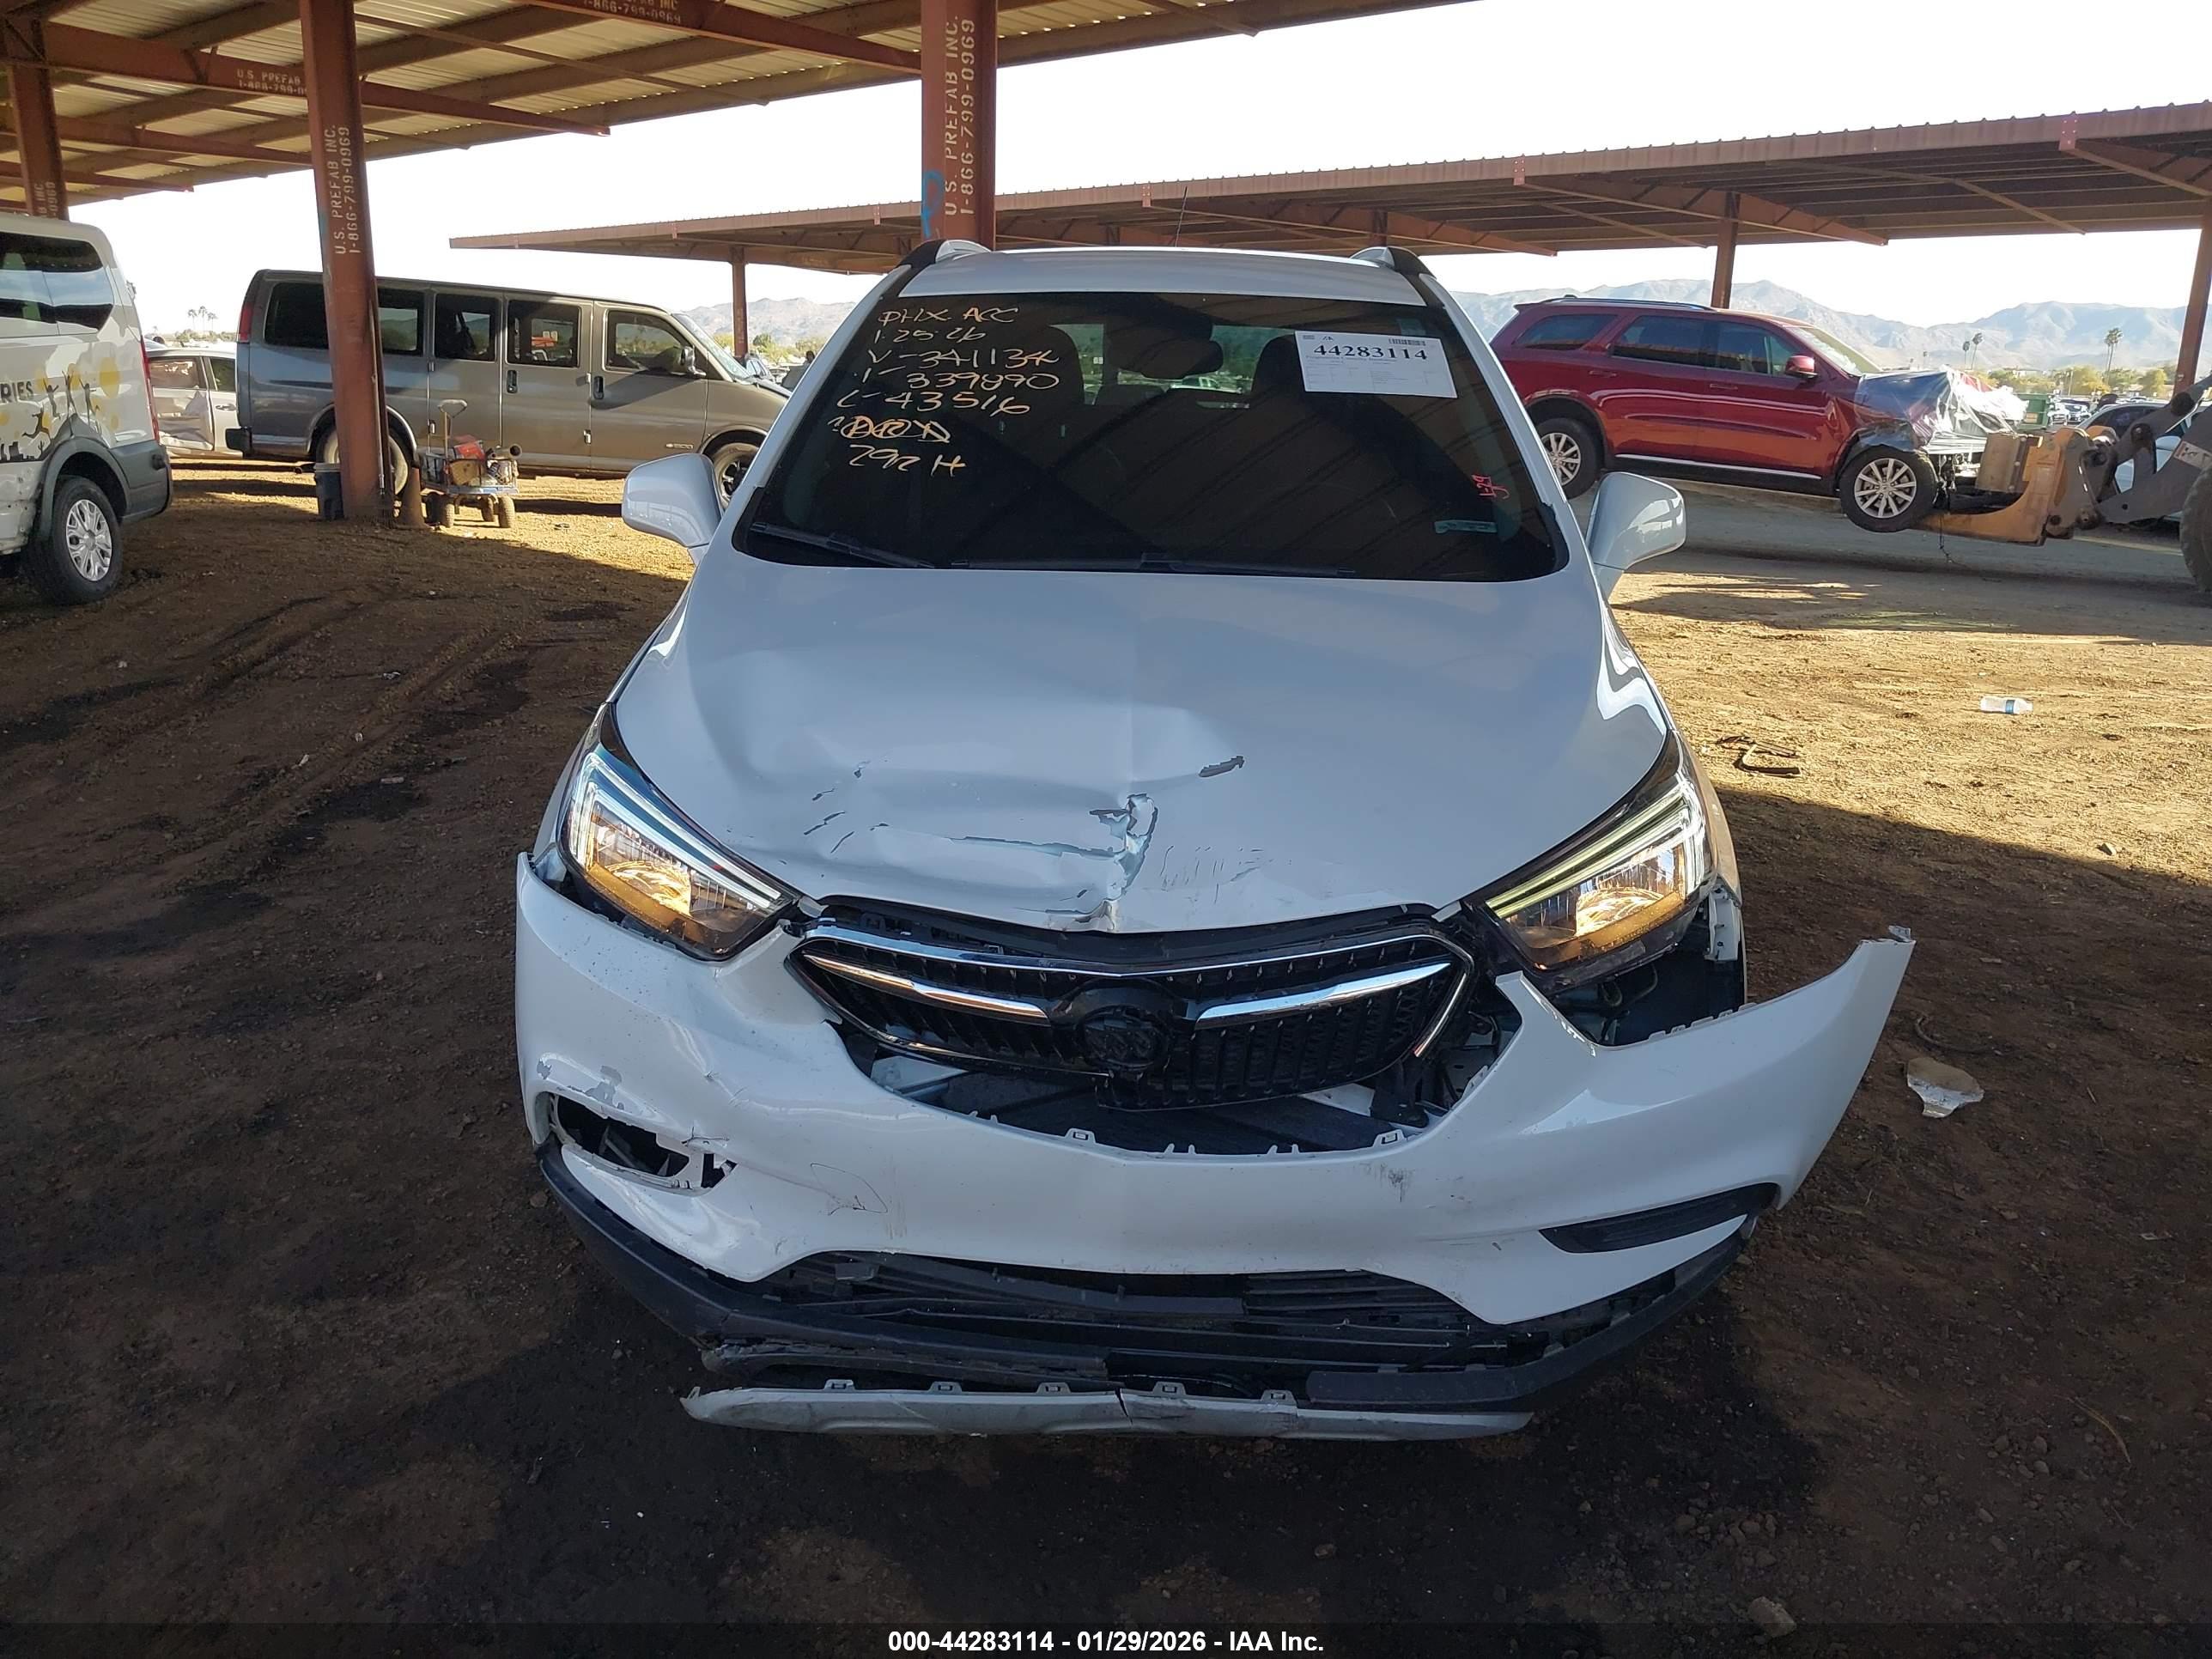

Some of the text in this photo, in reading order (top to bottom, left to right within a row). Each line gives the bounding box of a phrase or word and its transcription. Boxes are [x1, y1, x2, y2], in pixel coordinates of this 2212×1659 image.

[945, 15, 958, 216] U.S. PREFAB INC.
[961, 19, 975, 215] 1-866-799-0969
[324, 125, 348, 255] U.S. PREFAB INC.
[338, 126, 362, 254] 1-866-799-0969
[1314, 344, 1428, 361] 44283114
